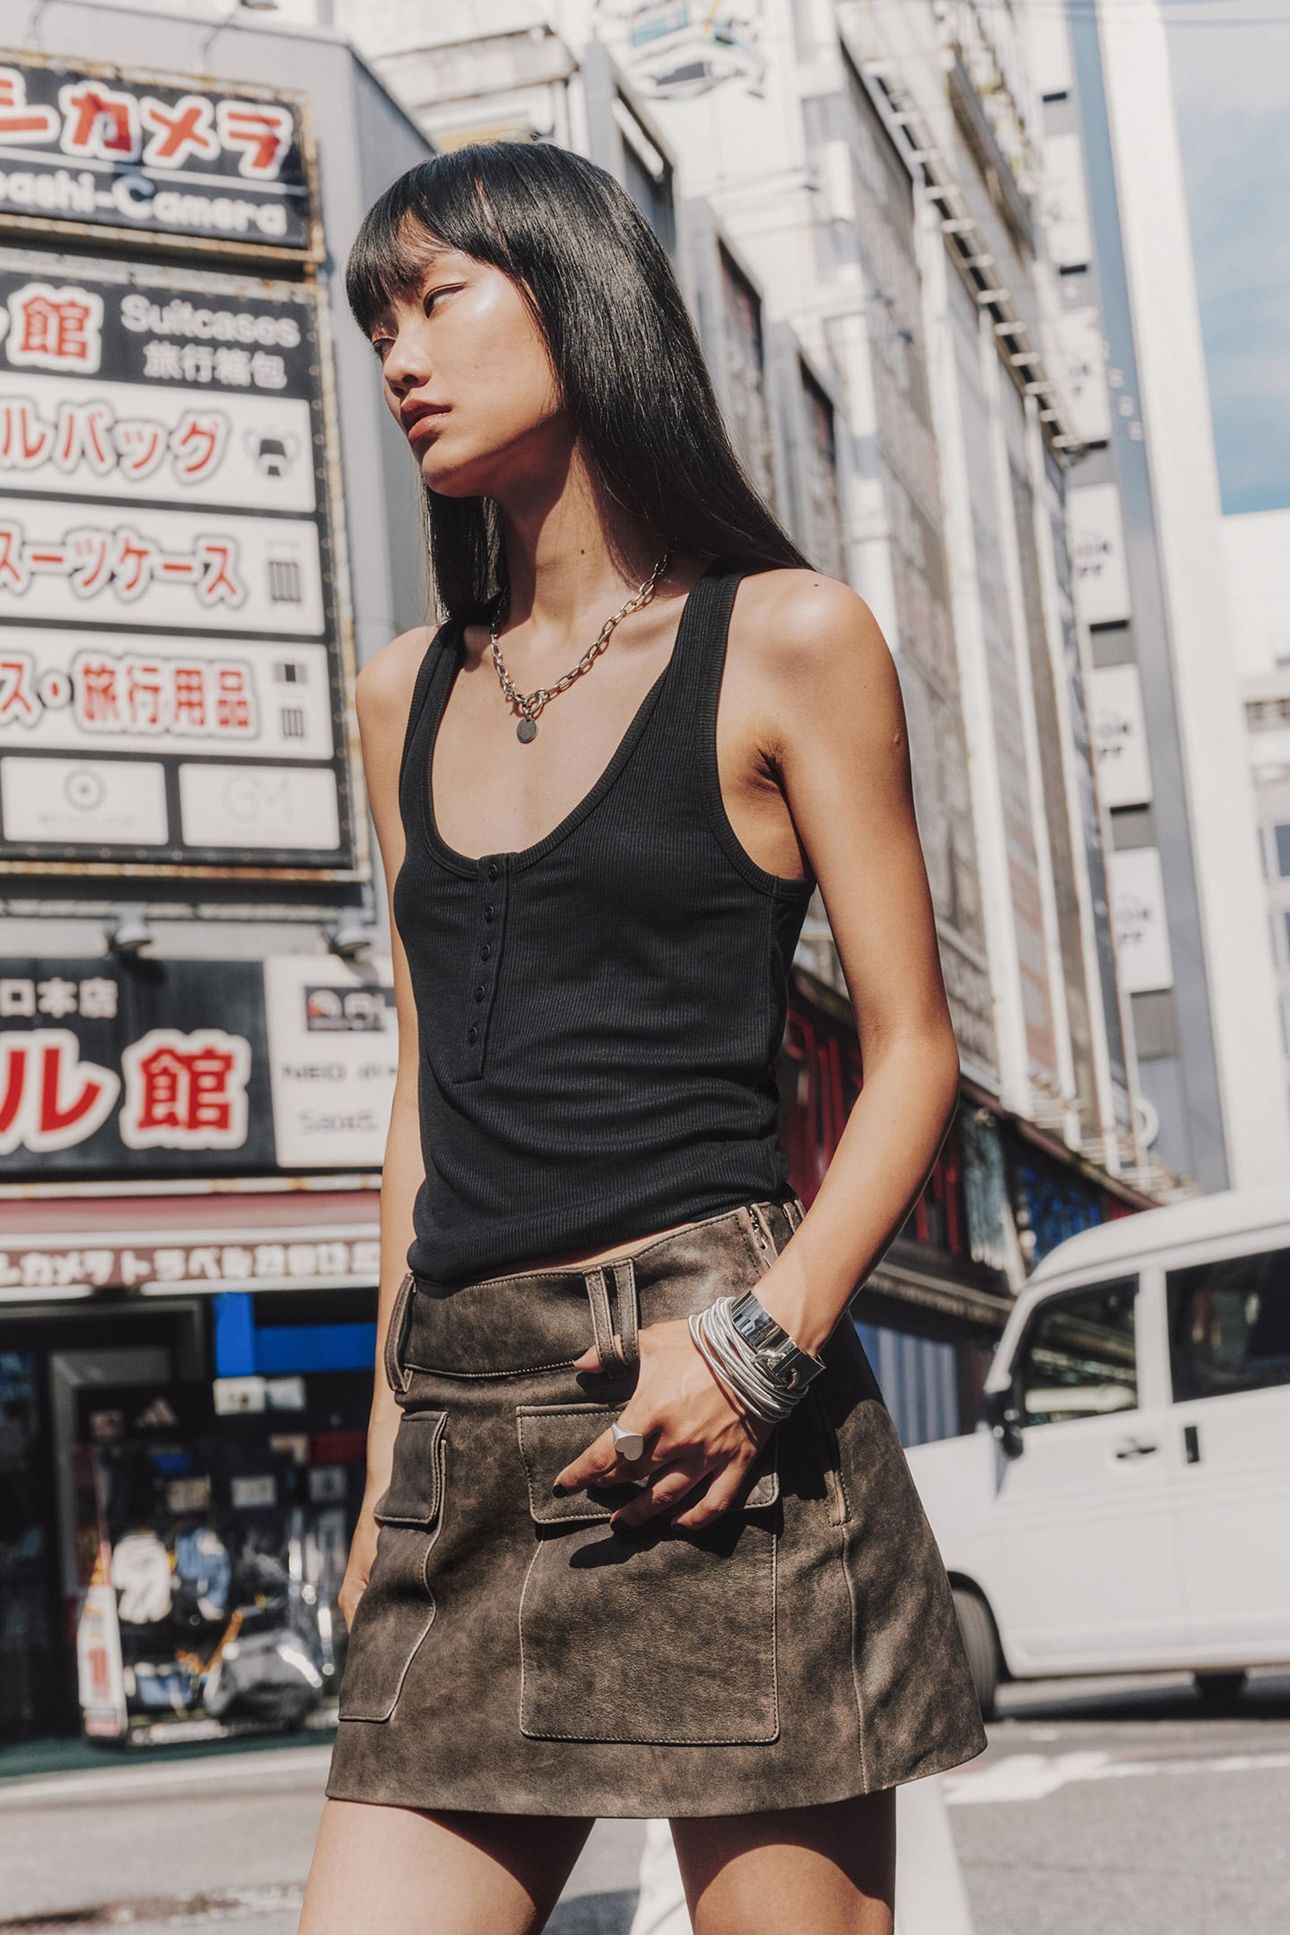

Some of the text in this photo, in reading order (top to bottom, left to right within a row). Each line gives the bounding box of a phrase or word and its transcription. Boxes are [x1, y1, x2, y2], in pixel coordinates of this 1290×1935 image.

[0, 170, 288, 237] ashi-Camera
[0, 282, 103, 374] 館
[121, 294, 300, 347] Suitcases
